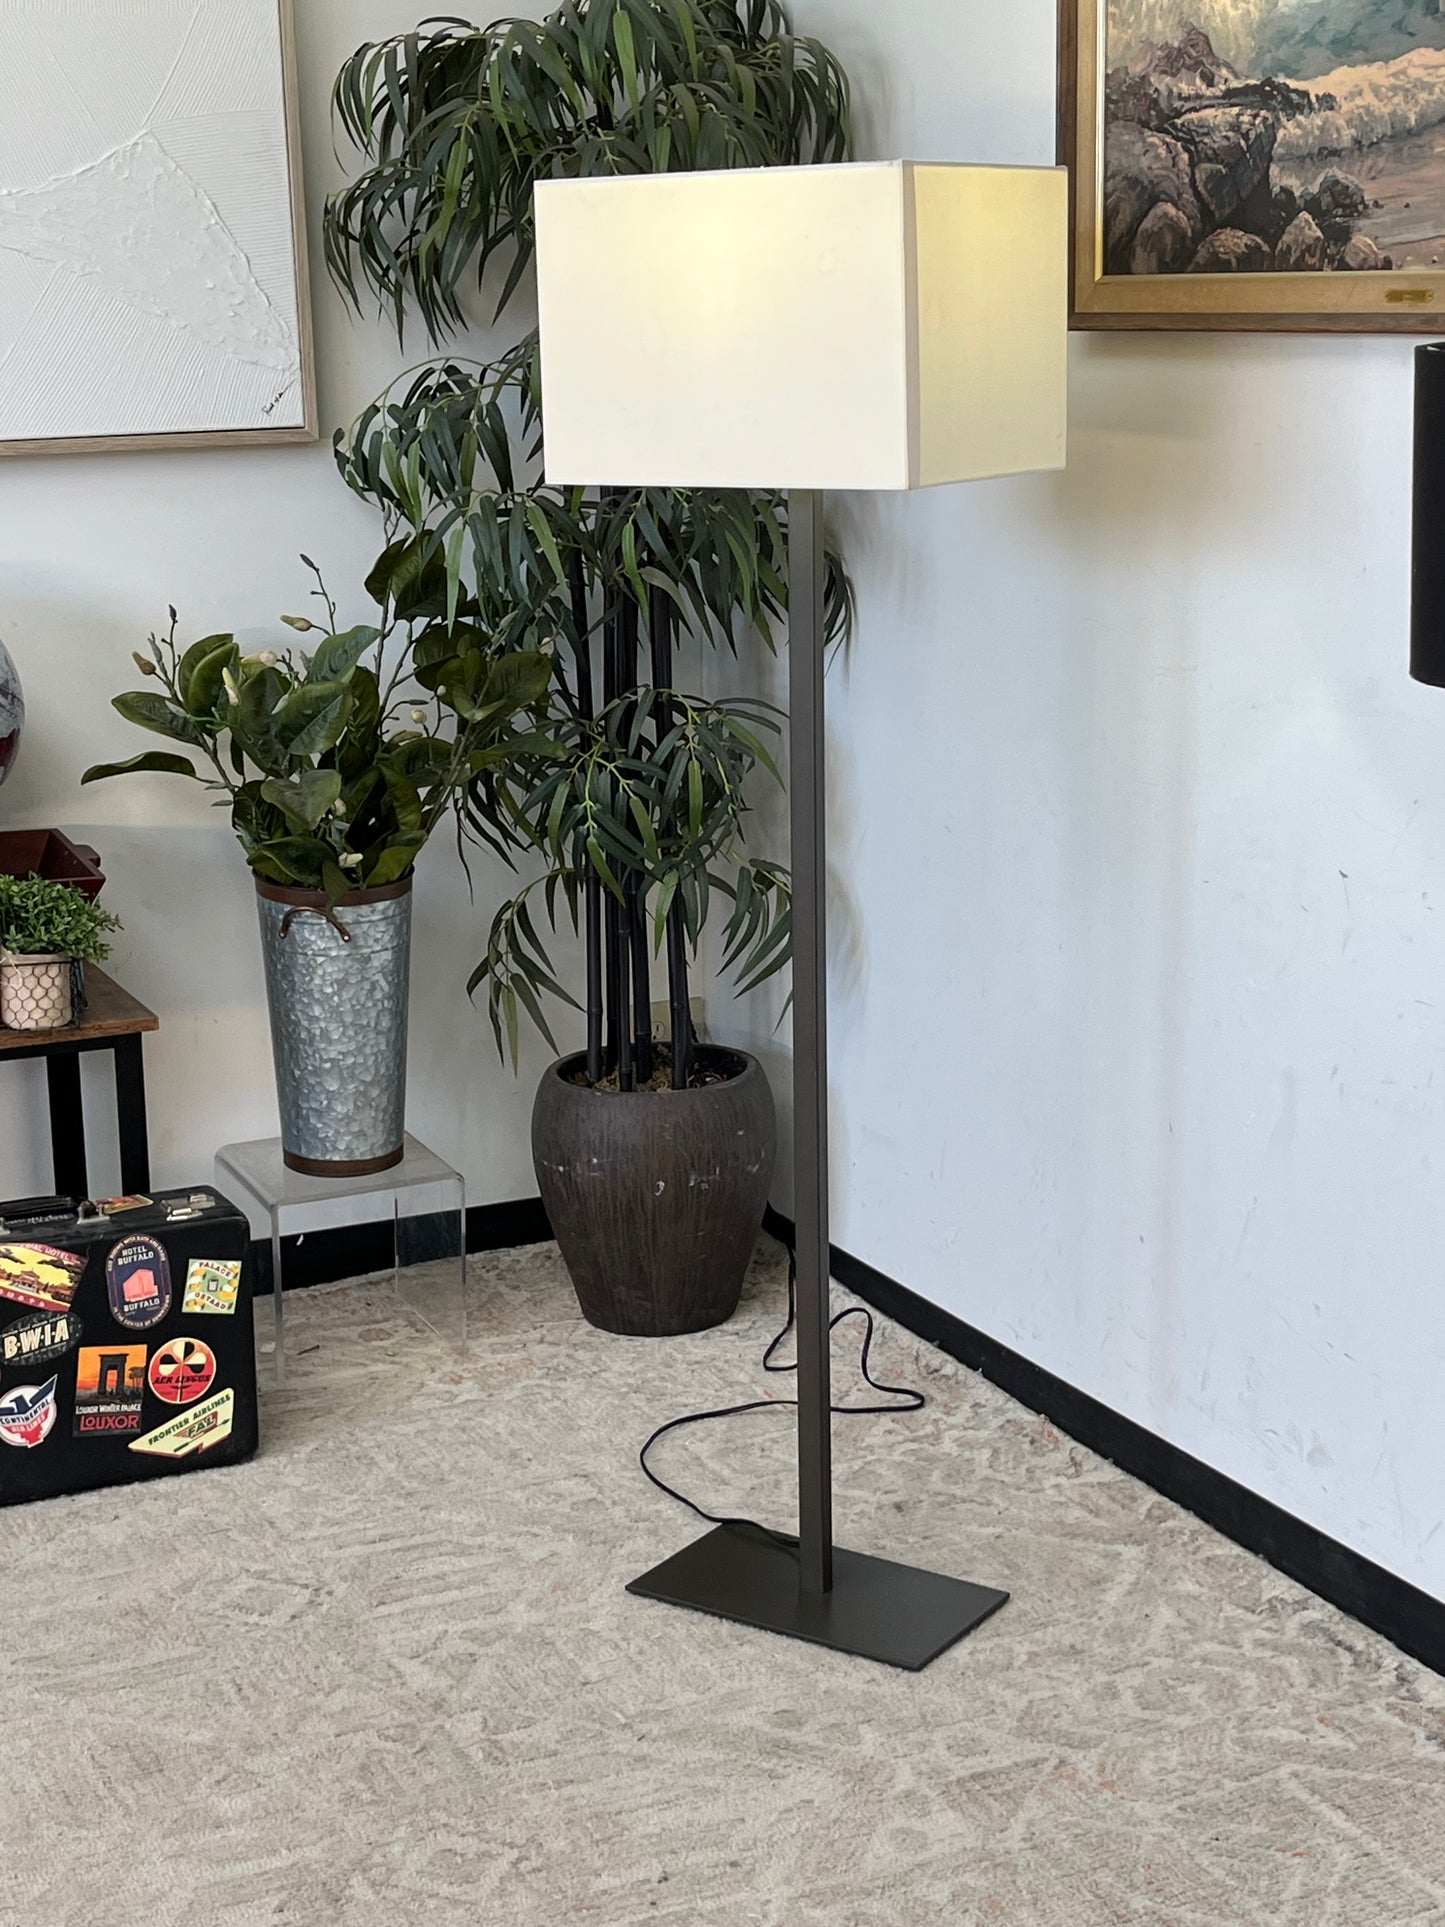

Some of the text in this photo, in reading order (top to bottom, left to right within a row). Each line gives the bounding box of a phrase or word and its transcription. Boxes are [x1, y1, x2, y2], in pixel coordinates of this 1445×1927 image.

[45, 1247, 70, 1260] HOTEL
[117, 1250, 155, 1266] BUFFALO
[121, 1245, 148, 1257] HOTEL
[198, 1261, 232, 1278] PALACE
[123, 1297, 160, 1312] BUFFALO
[0, 1398, 50, 1425] CONTINENTAL
[147, 1393, 231, 1446] FRONTIER AIRLINES
[80, 1414, 140, 1431] LOUXOR
[187, 1416, 215, 1438] FAL
